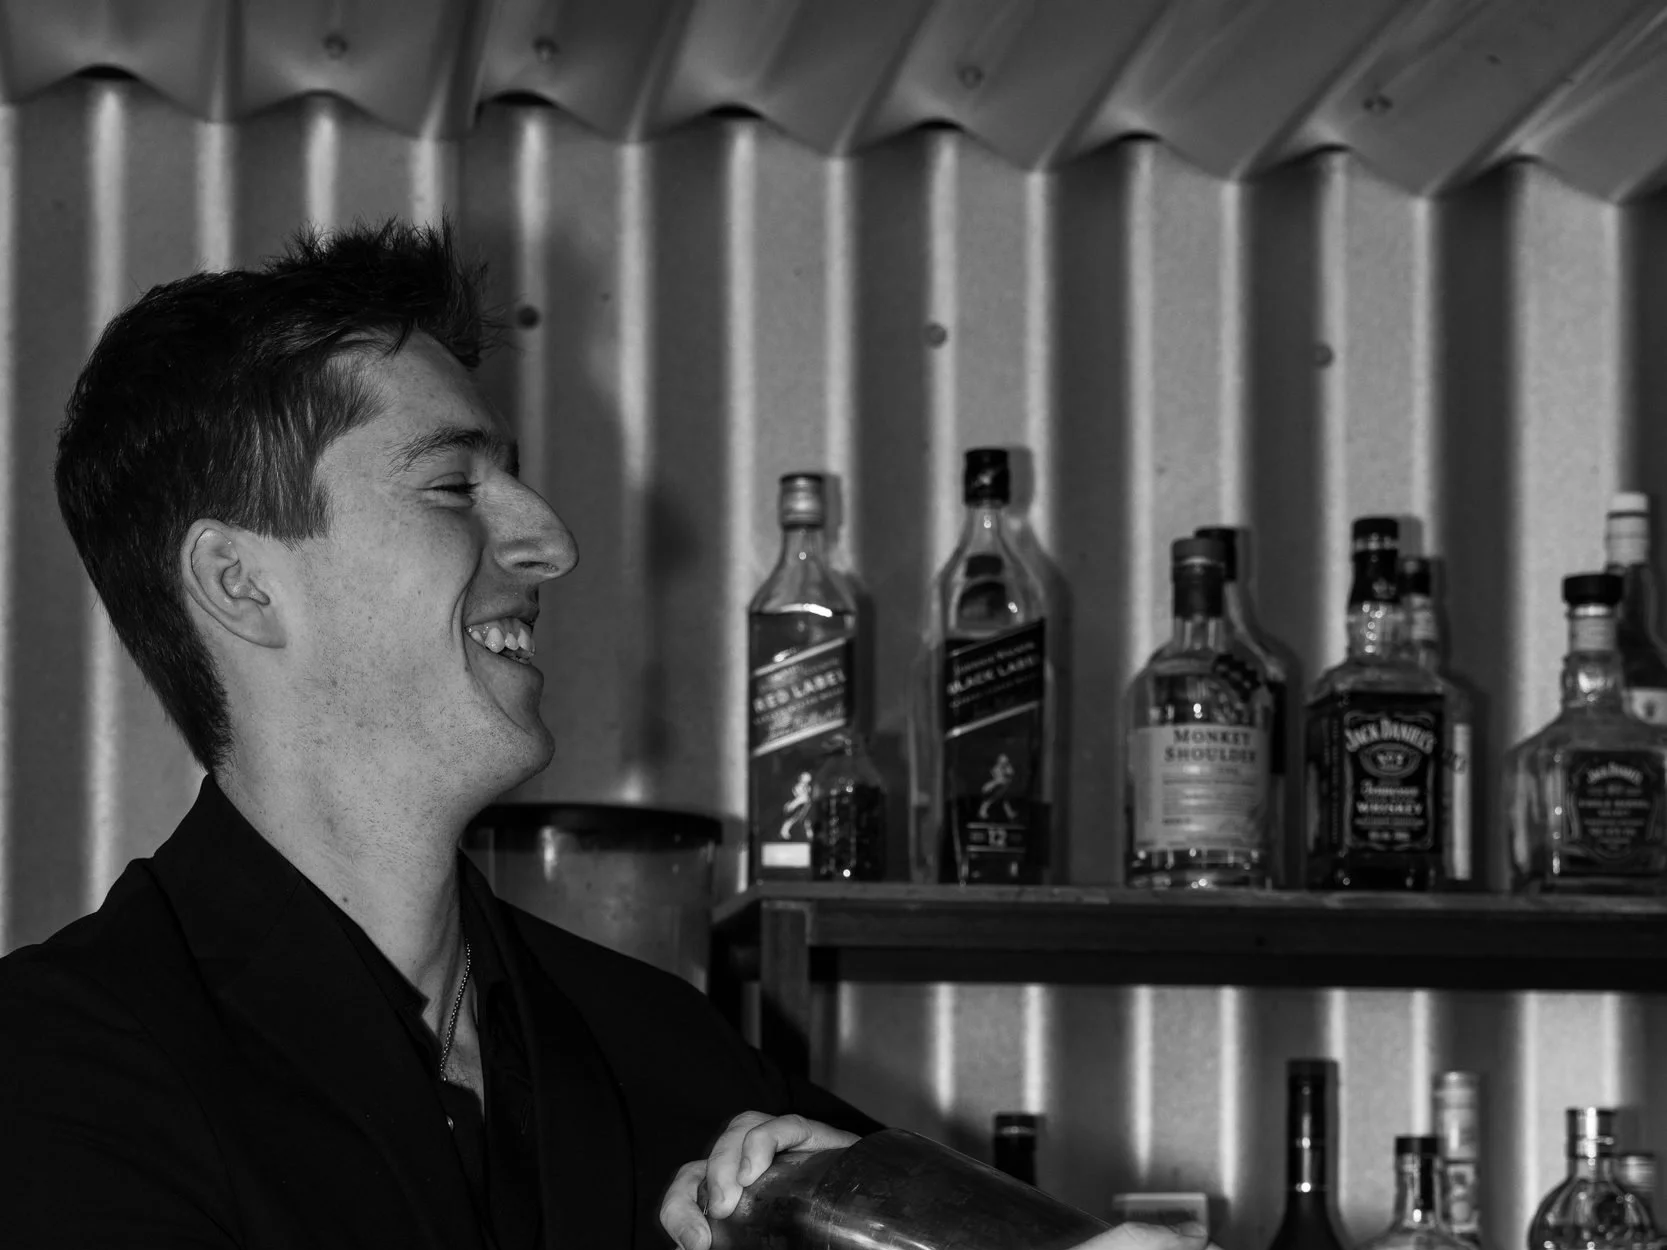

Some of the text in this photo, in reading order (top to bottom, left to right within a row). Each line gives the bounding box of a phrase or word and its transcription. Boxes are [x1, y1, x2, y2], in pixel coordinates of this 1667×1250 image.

[1173, 728, 1253, 746] MONKEY
[1343, 721, 1380, 753] JACK
[1164, 744, 1257, 762] SHOULDER
